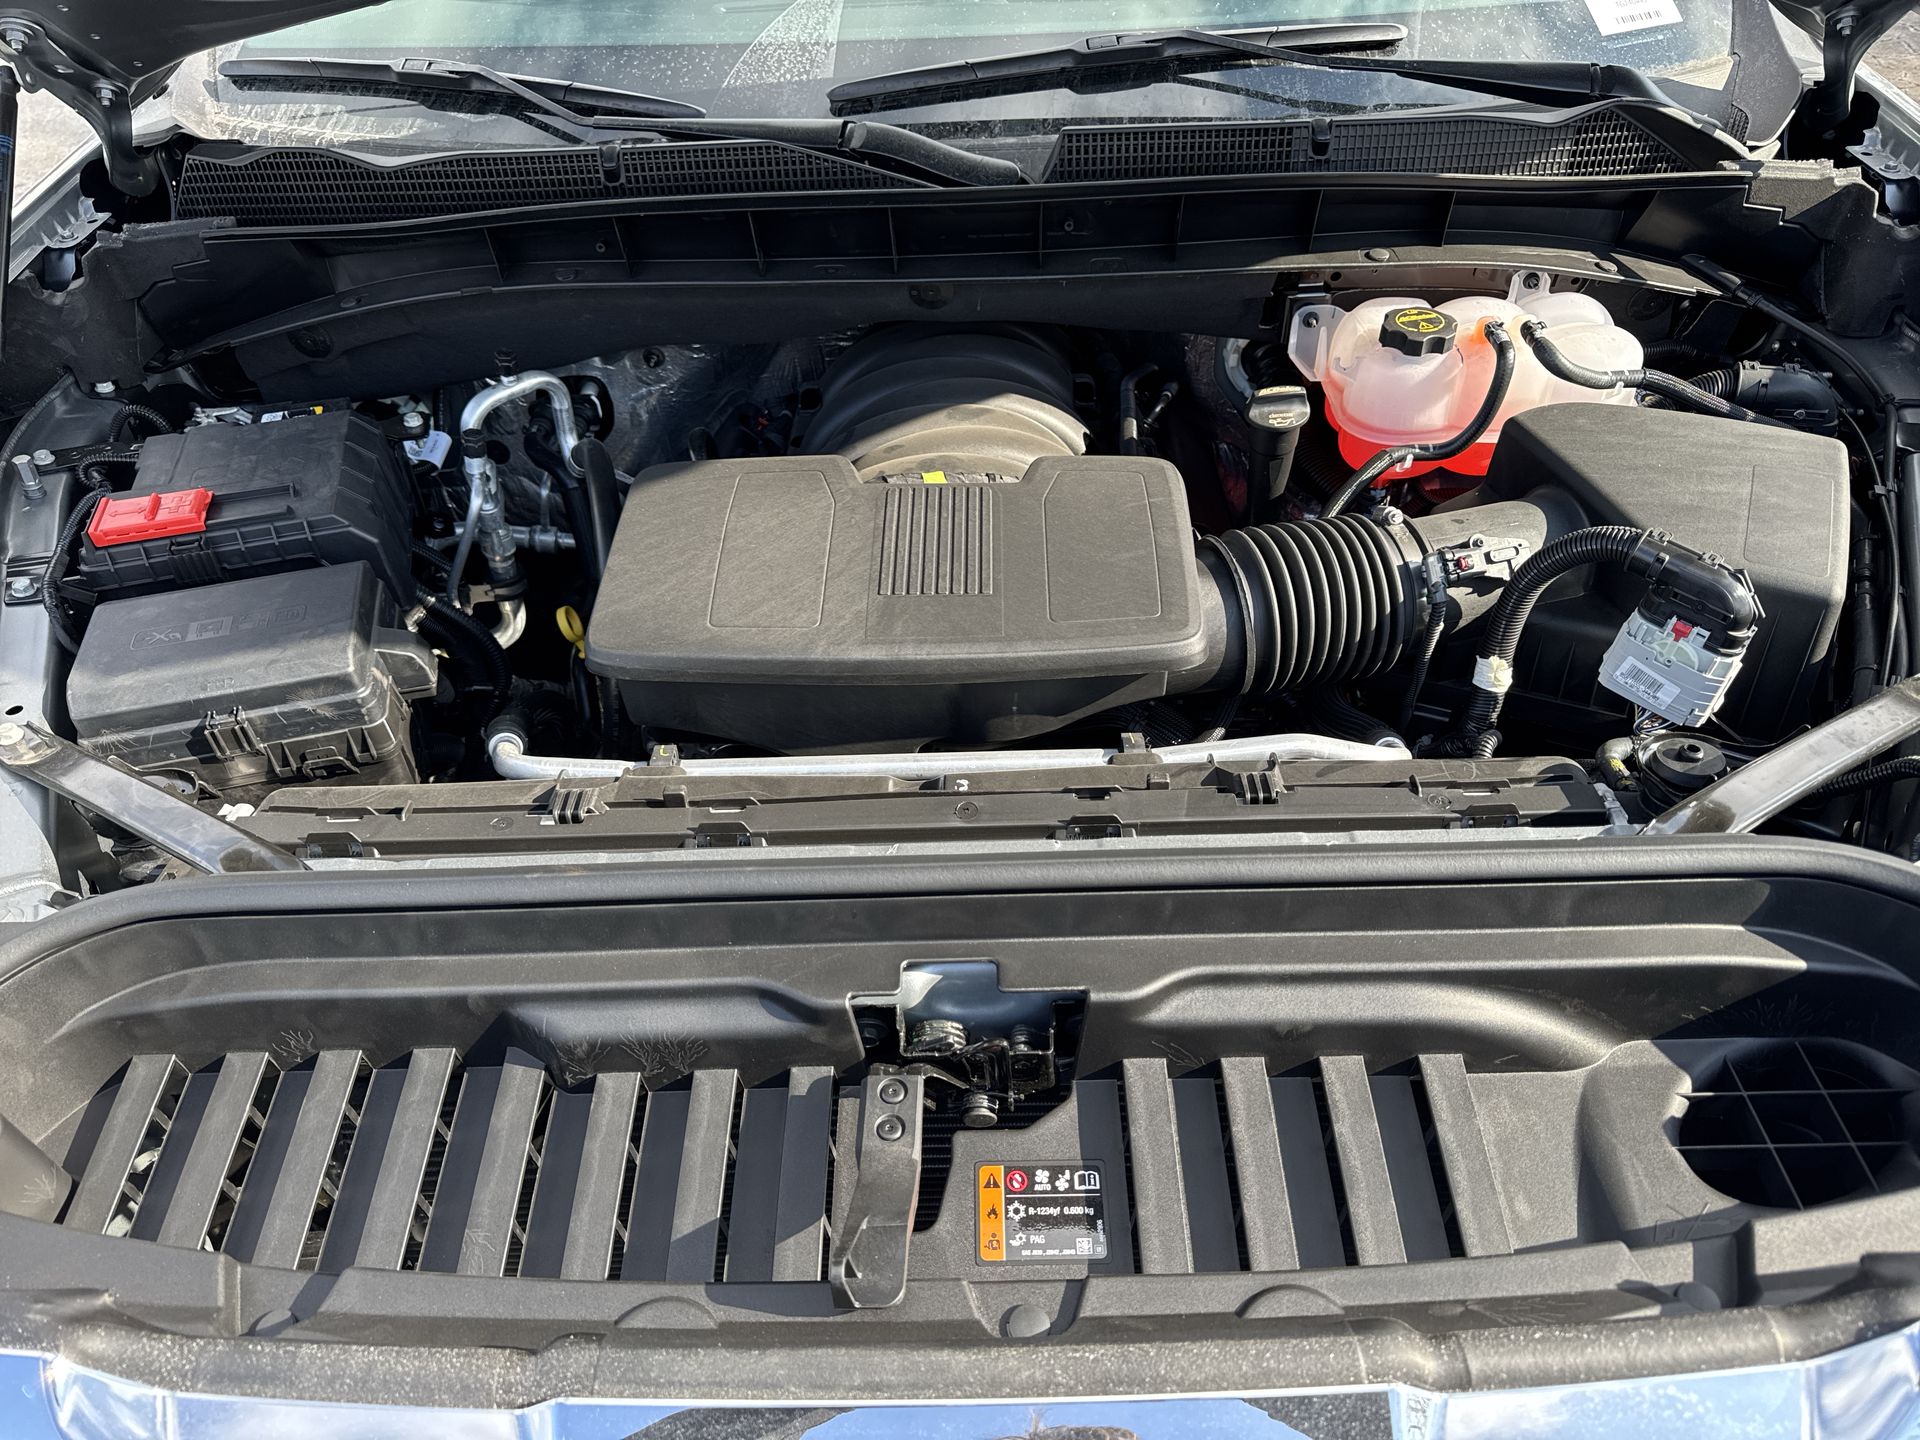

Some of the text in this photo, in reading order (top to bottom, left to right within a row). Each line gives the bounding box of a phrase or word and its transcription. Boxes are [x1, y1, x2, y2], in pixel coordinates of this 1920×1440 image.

[1034, 1183, 1051, 1191] AUTO
[1028, 1206, 1061, 1217] R-1234yf
[1085, 1206, 1094, 1216] kg
[1030, 1235, 1045, 1244] PAG
